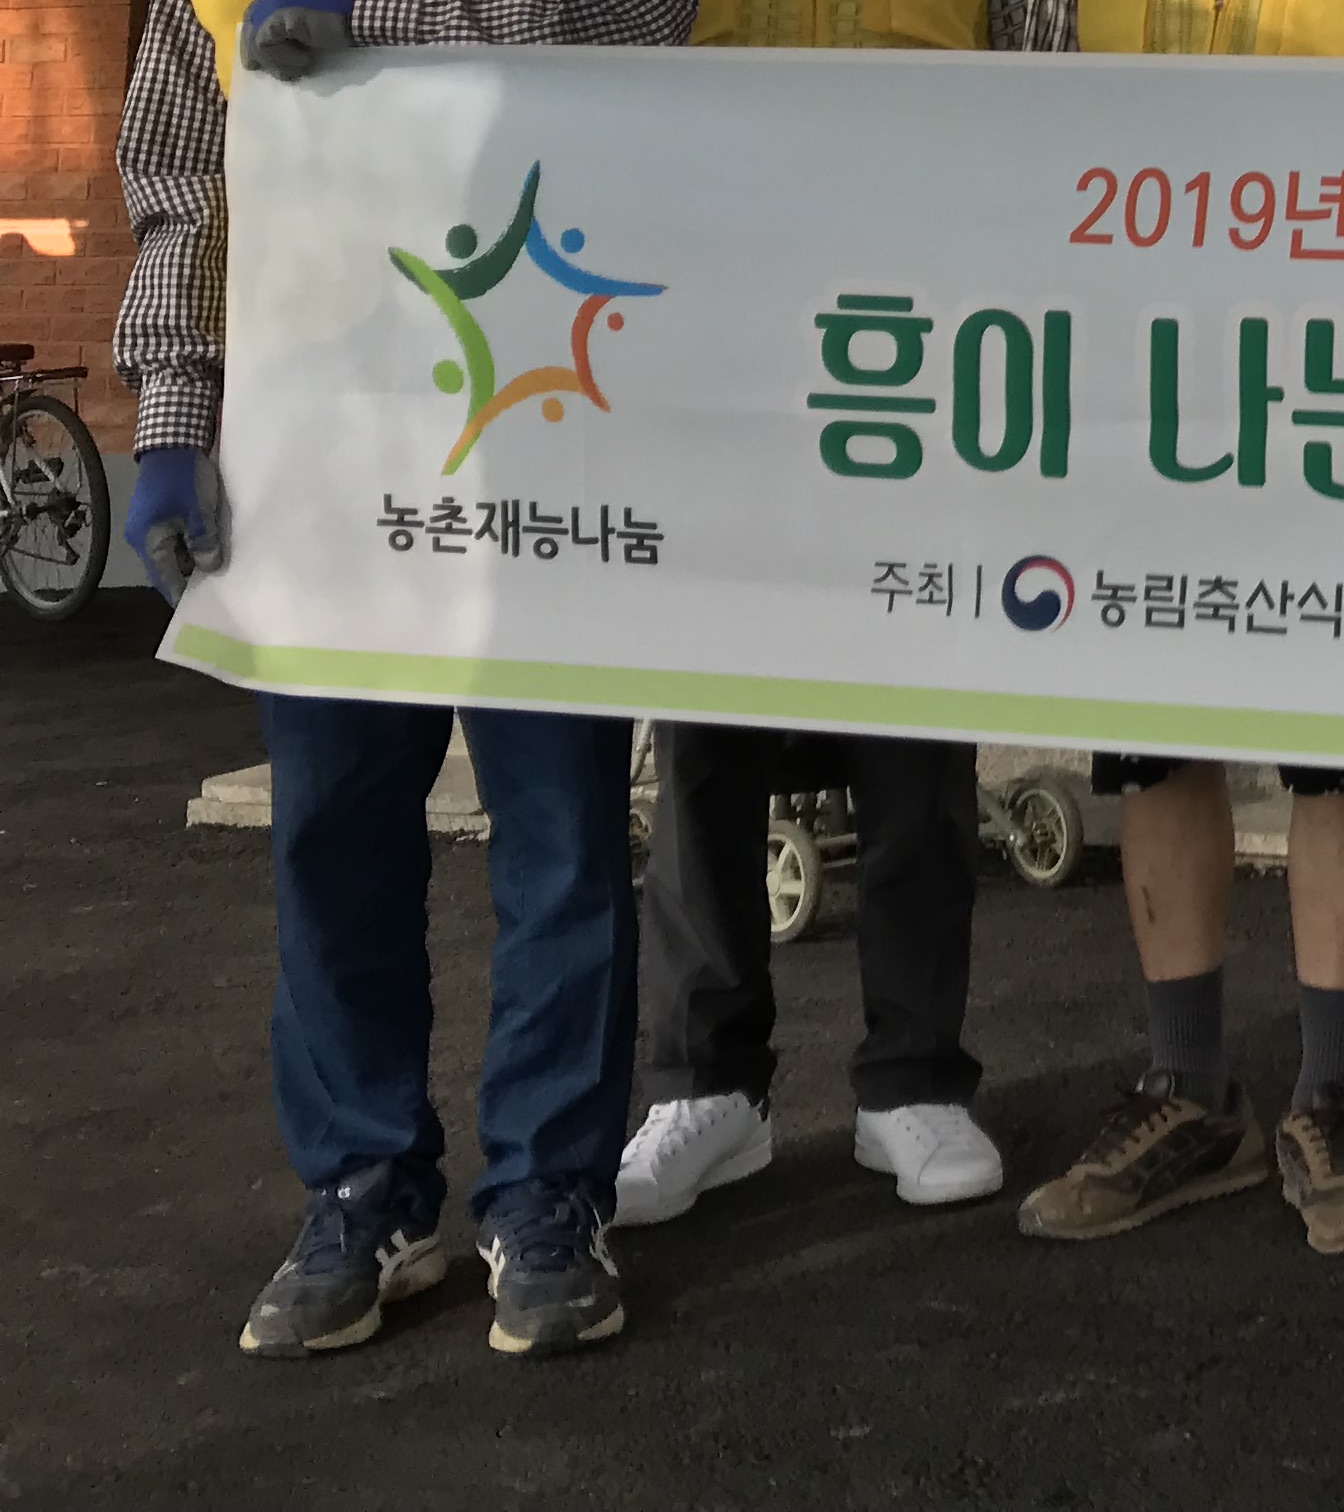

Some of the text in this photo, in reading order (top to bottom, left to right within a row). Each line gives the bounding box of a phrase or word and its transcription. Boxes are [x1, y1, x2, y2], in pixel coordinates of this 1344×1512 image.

[807, 294, 1072, 482] 흥이
[377, 494, 665, 567] 농촌재능나눔
[871, 562, 955, 618] 주최
